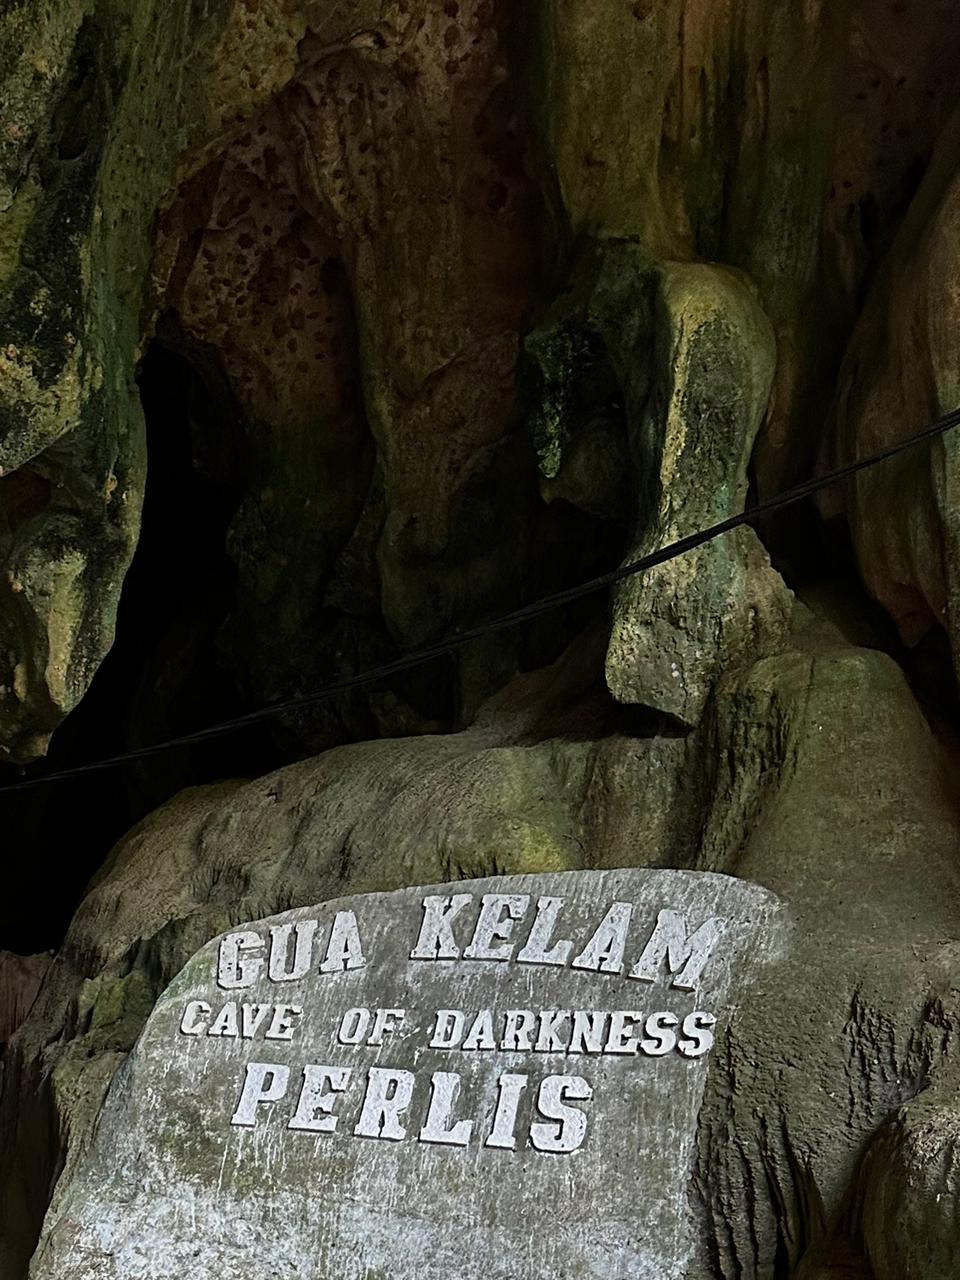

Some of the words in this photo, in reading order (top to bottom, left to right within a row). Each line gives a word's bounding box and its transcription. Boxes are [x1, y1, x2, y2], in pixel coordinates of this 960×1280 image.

[216, 911, 366, 989] GUA
[410, 894, 728, 990] KELAM
[180, 1000, 303, 1041] CAVE
[337, 1007, 406, 1047] OF
[429, 1008, 718, 1057] DARKNESS
[230, 1062, 593, 1153] PERLIS
